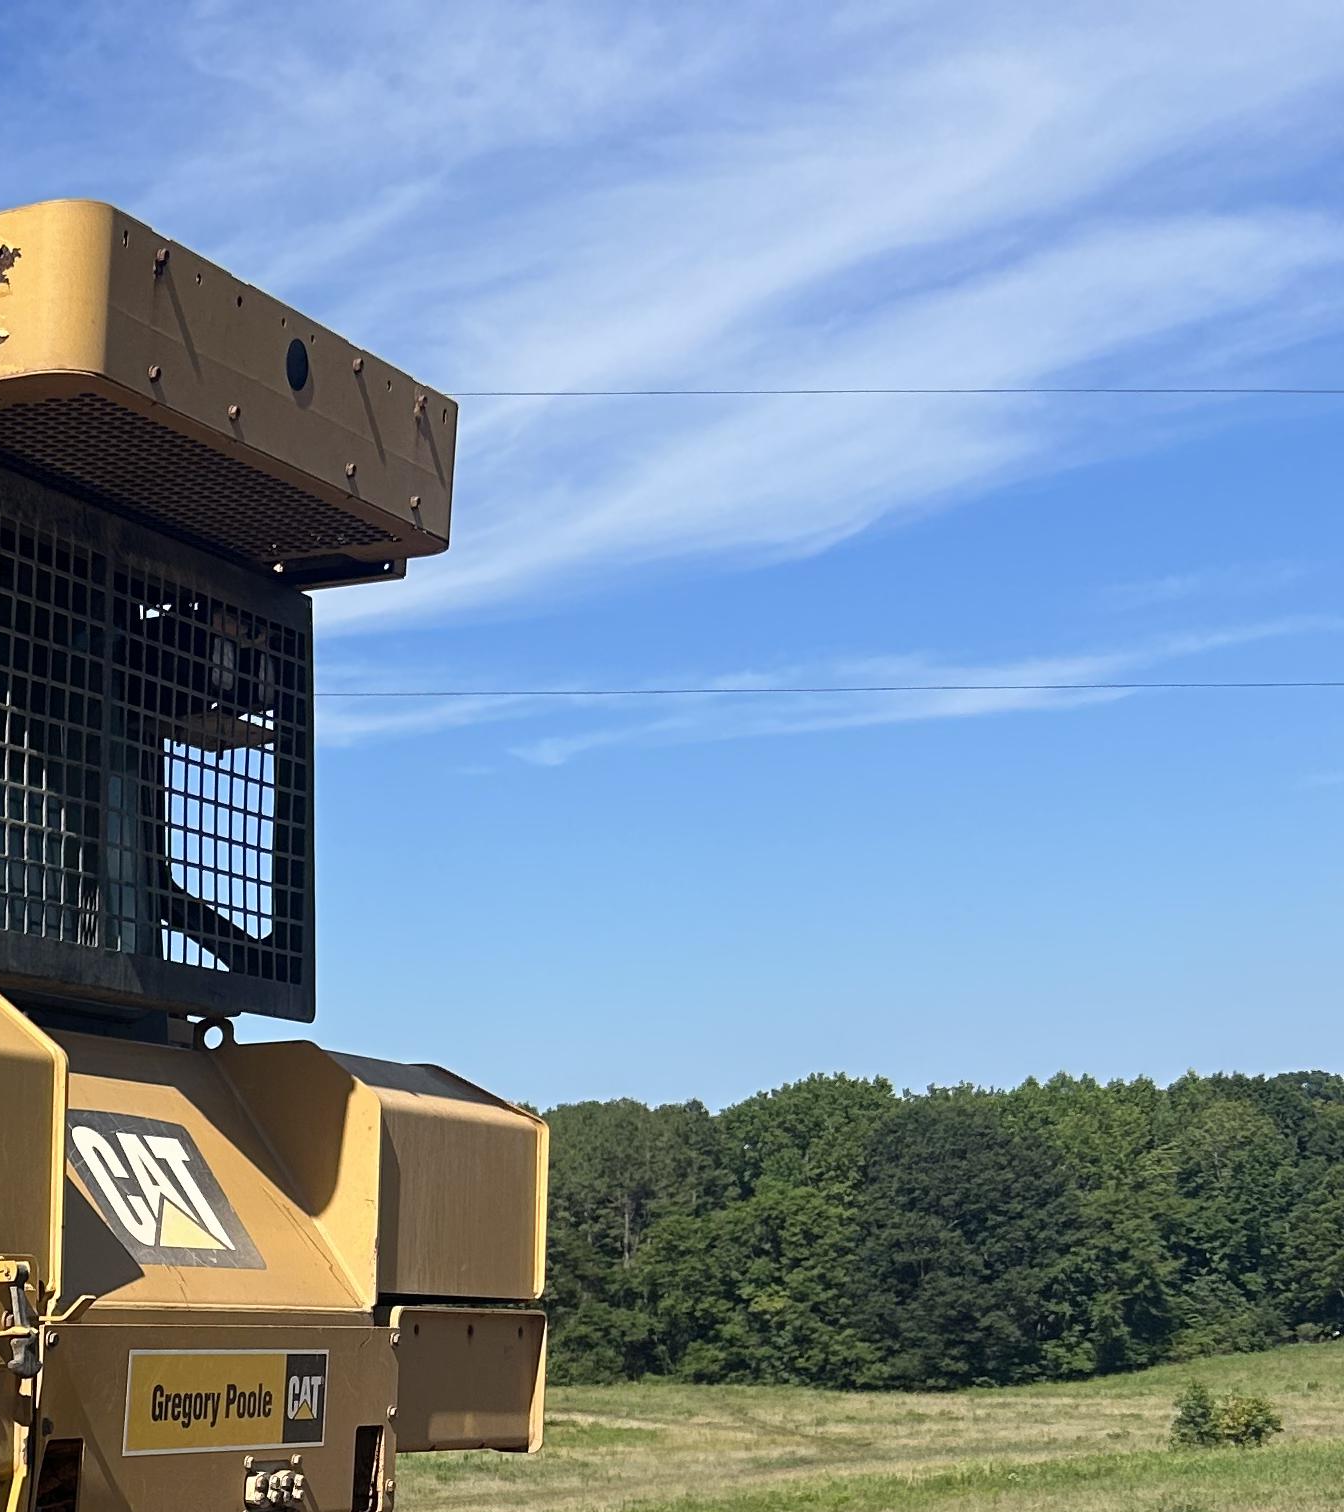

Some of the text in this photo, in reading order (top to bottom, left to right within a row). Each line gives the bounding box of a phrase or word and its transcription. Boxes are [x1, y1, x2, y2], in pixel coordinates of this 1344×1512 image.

[71, 1125, 237, 1251] CAT
[151, 1383, 273, 1428] Gregory Poole
[287, 1375, 323, 1421] CAT
